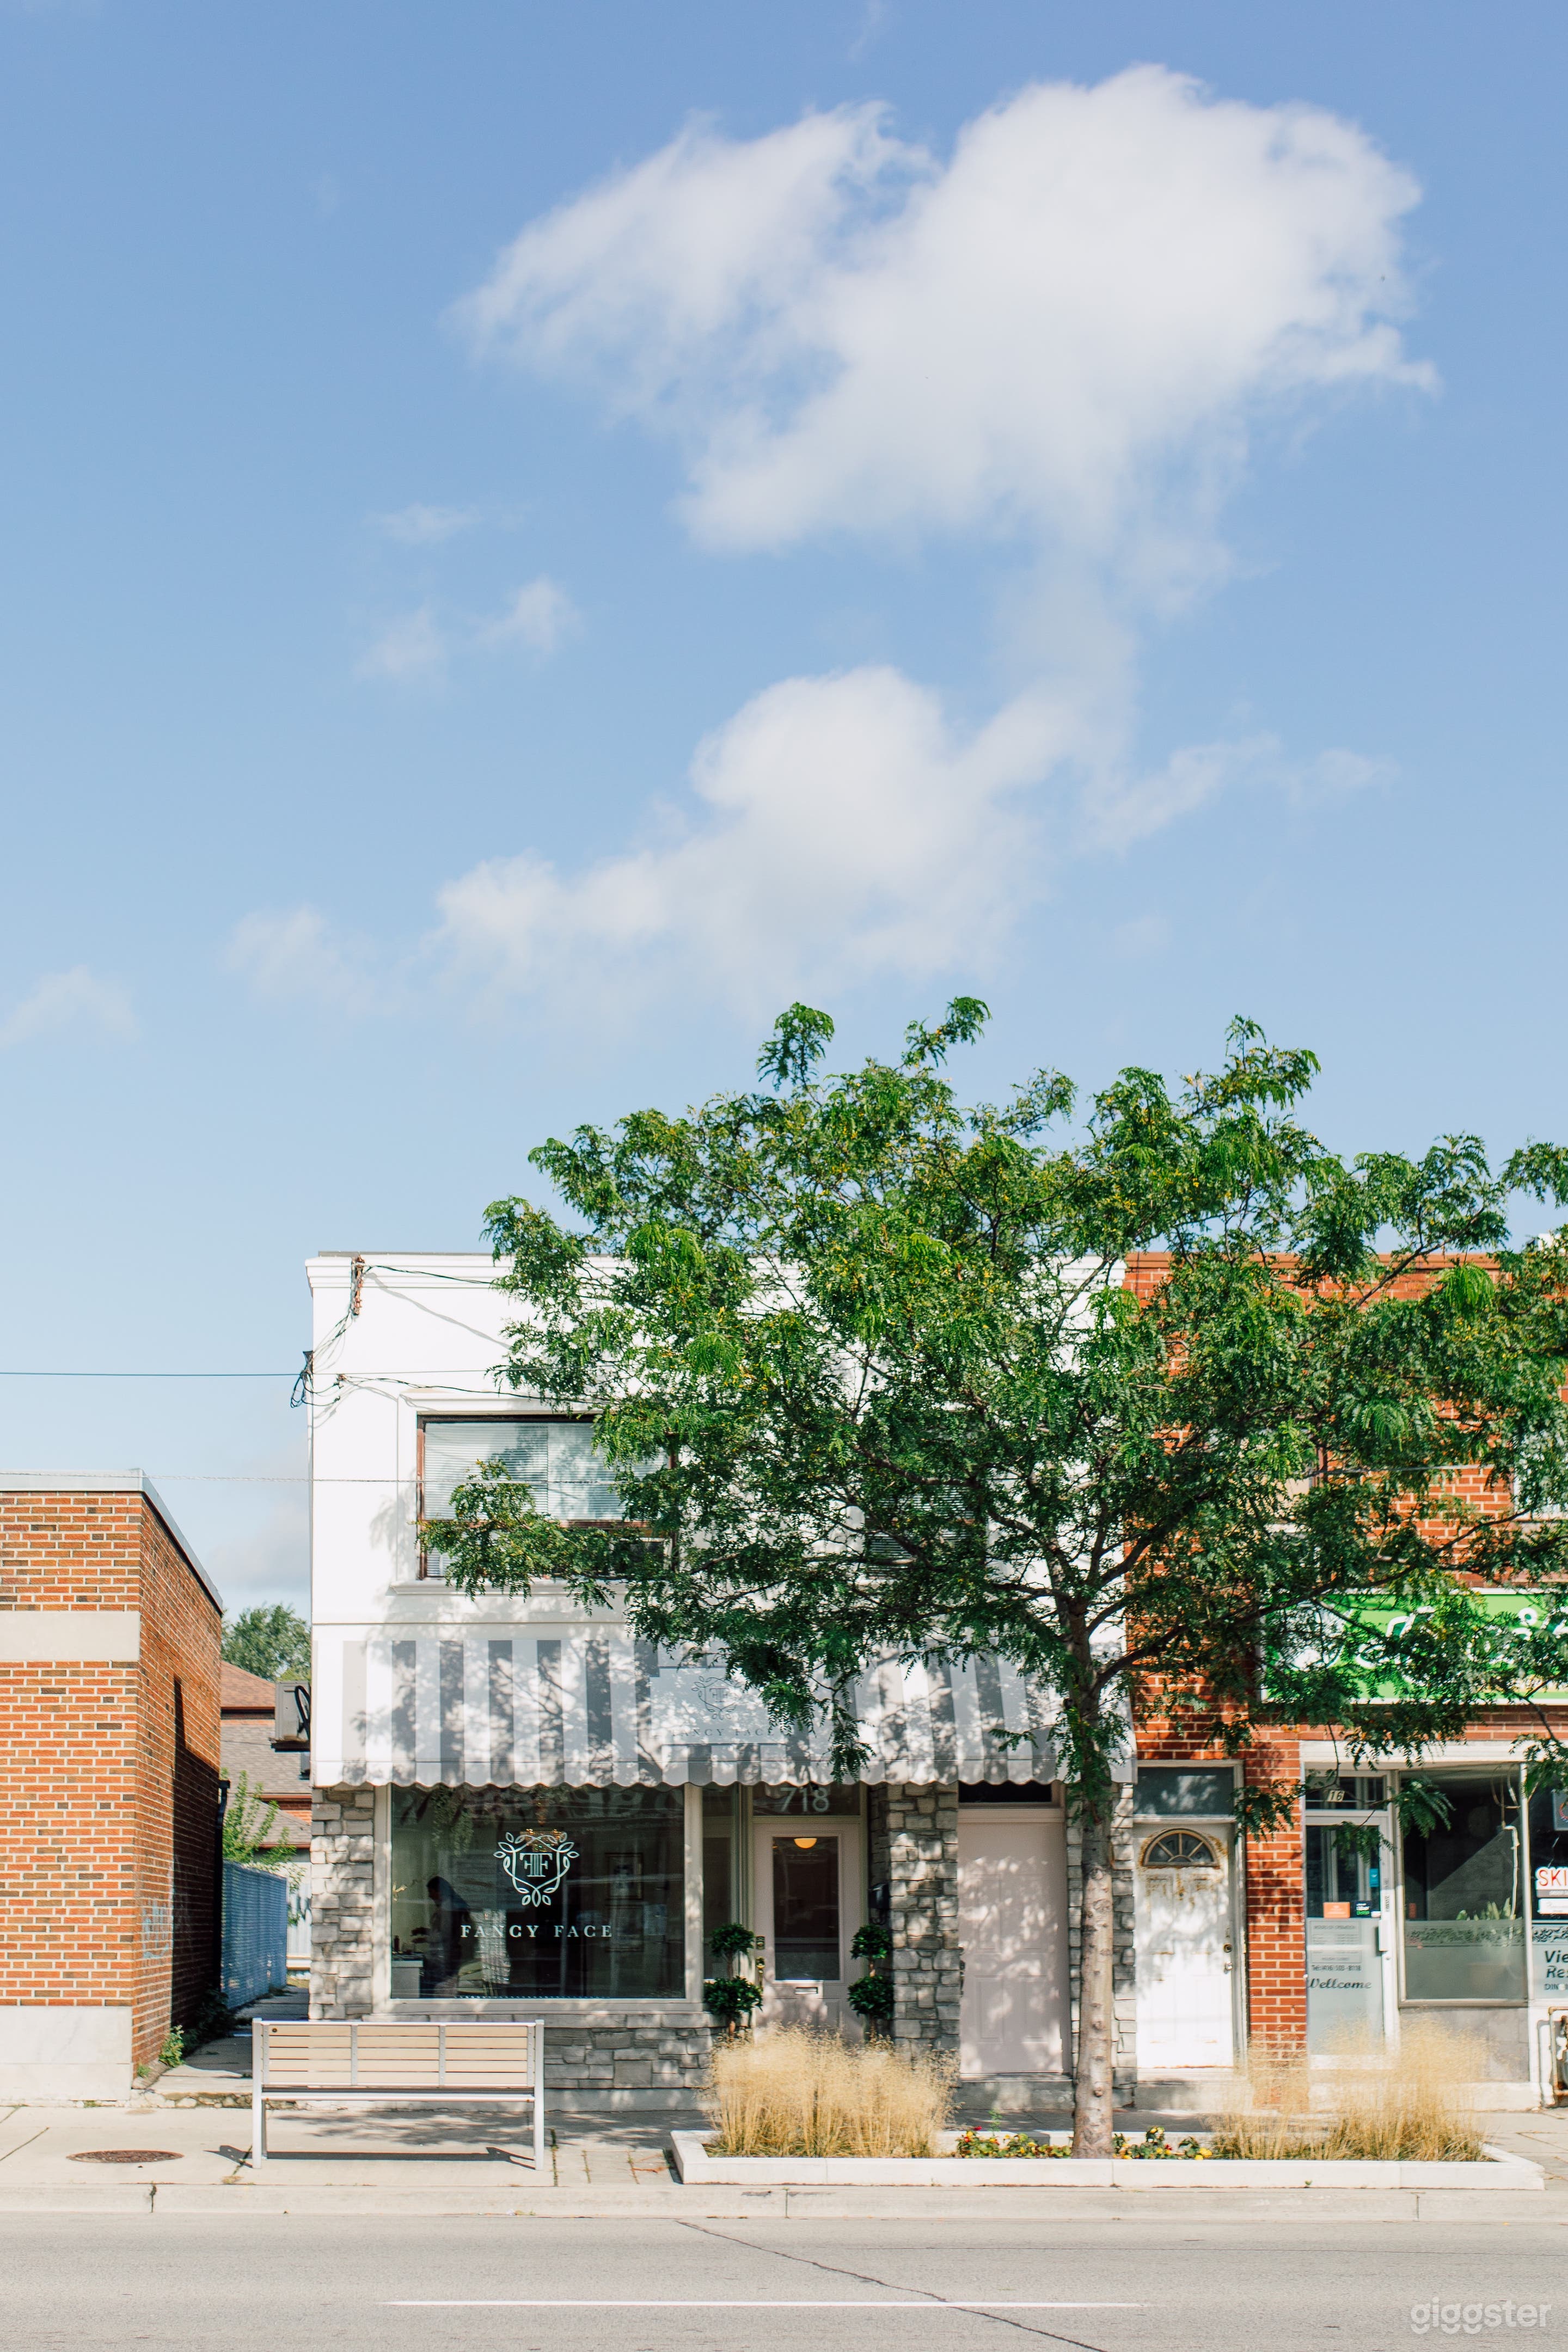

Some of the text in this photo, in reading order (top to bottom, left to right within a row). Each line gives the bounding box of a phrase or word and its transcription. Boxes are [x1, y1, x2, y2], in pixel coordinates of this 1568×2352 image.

[780, 1787, 830, 1812] 718
[461, 1925, 612, 1938] FANCY FACE
